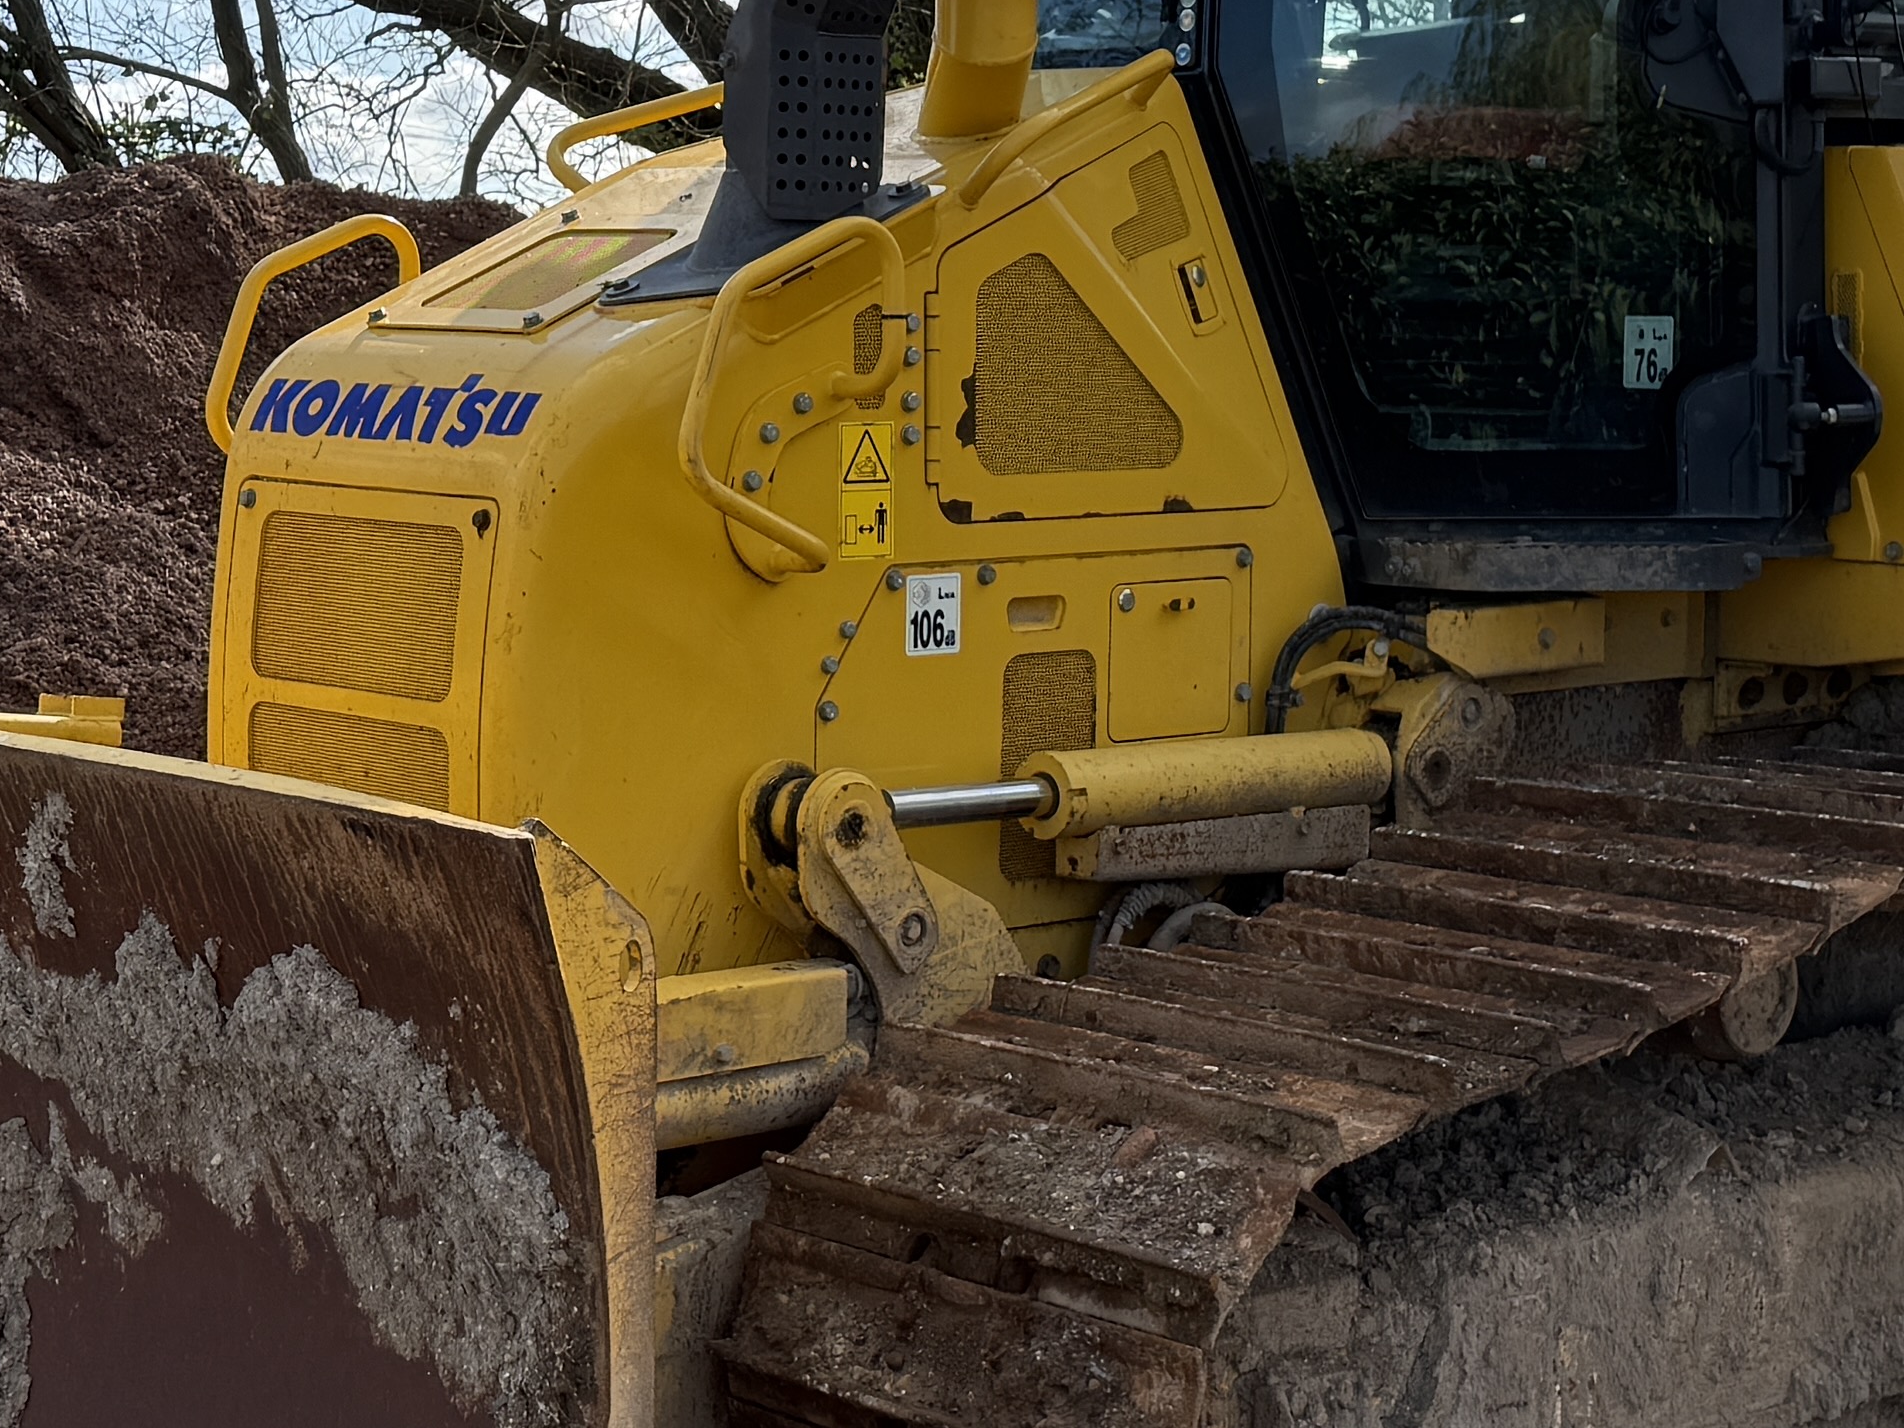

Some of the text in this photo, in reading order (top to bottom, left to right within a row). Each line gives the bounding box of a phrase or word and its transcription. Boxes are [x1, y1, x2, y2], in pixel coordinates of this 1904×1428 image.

[1634, 348, 1657, 383] 76
[249, 374, 542, 448] KOMATSU
[910, 609, 945, 649] 106
